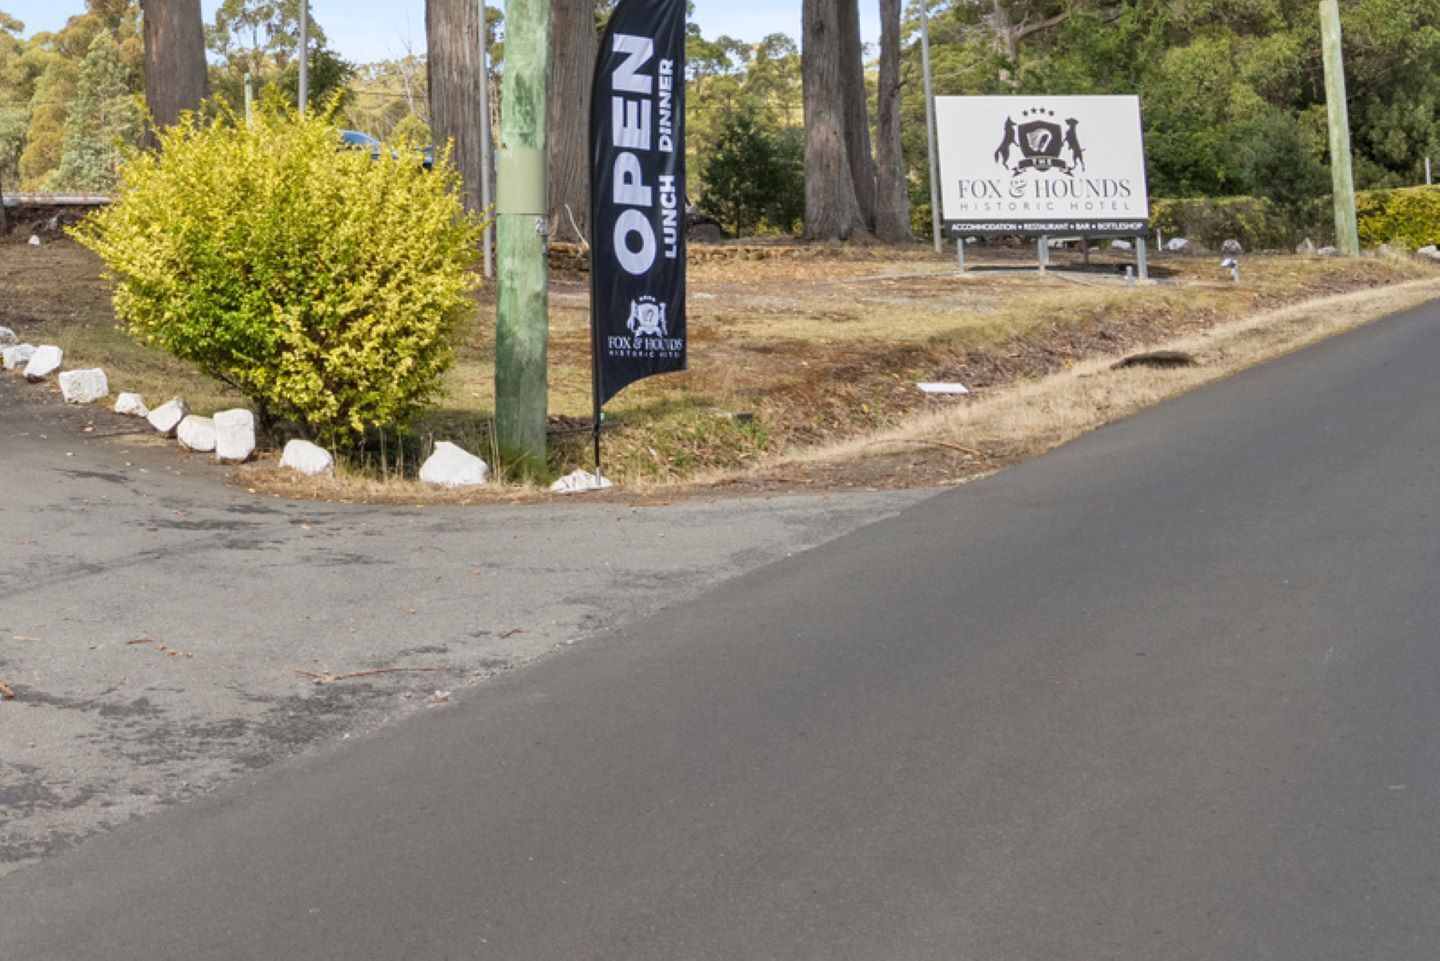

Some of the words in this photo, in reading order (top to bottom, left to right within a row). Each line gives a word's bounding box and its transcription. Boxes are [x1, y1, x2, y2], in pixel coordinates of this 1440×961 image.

[659, 58, 674, 153] DINNER
[612, 33, 656, 275] OPEN
[958, 179, 1002, 199] FOX
[1009, 179, 1027, 199] &
[1035, 178, 1131, 199] HOUNDS
[660, 174, 678, 259] LUNCH
[960, 201, 1055, 211] HISTORIC
[1070, 201, 1130, 211] HOTEL
[951, 223, 1017, 231] ACCOMMODATION
[1023, 223, 1069, 231] RESTAURANT
[1097, 222, 1143, 230] BOTTLESHOP
[608, 336, 632, 349] FOX
